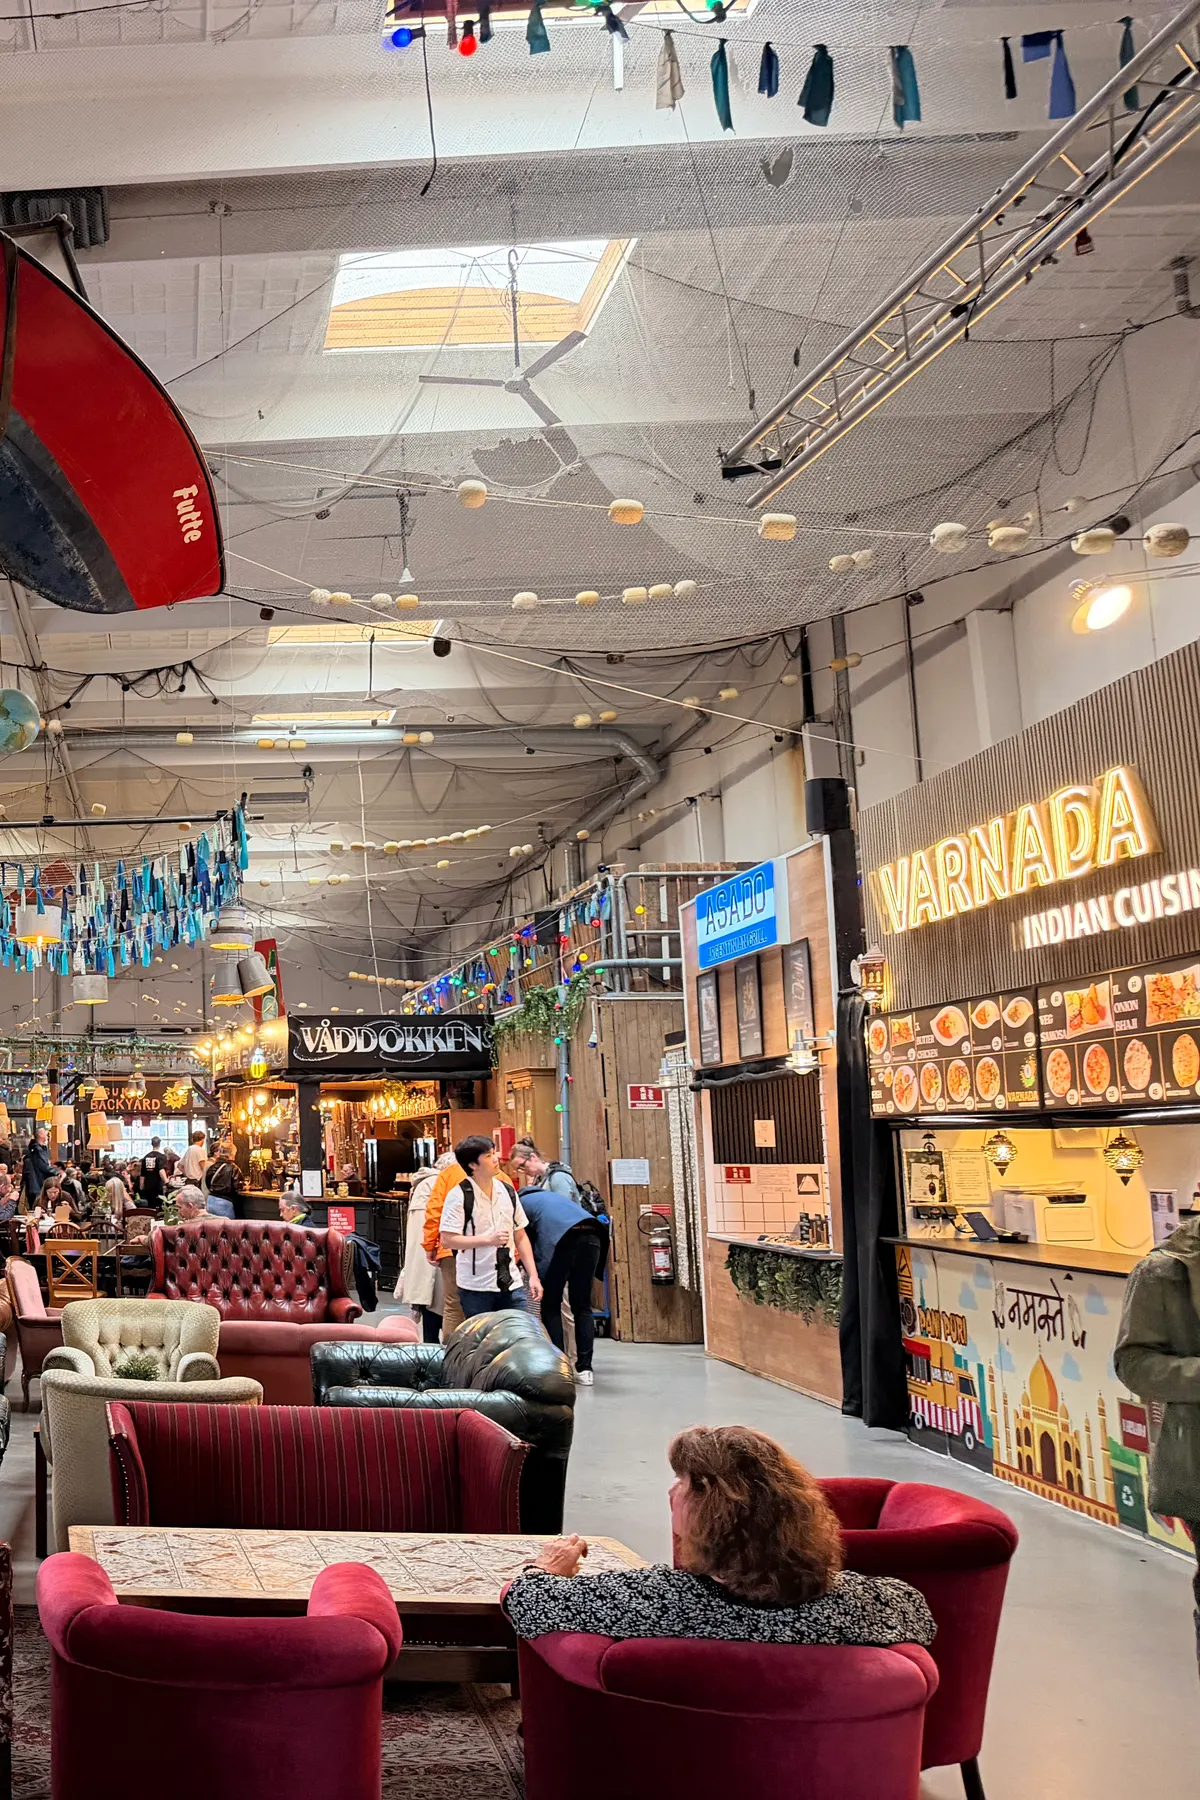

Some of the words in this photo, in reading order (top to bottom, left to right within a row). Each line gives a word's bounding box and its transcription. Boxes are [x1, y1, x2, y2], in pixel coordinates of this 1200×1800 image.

[172, 484, 203, 544] Futte
[878, 764, 1150, 934] VARNADA
[705, 870, 766, 935] ASADO
[1023, 895, 1109, 950] INDIAN
[707, 933, 749, 962] ARGENTINIAN
[748, 926, 768, 947] GRILL
[1114, 999, 1139, 1014] ONION
[300, 1018, 483, 1053] VÅDDOKKEN
[90, 1098, 161, 1110] BACKYARD
[918, 1305, 941, 1340] PANI
[941, 1311, 968, 1347] PURI
